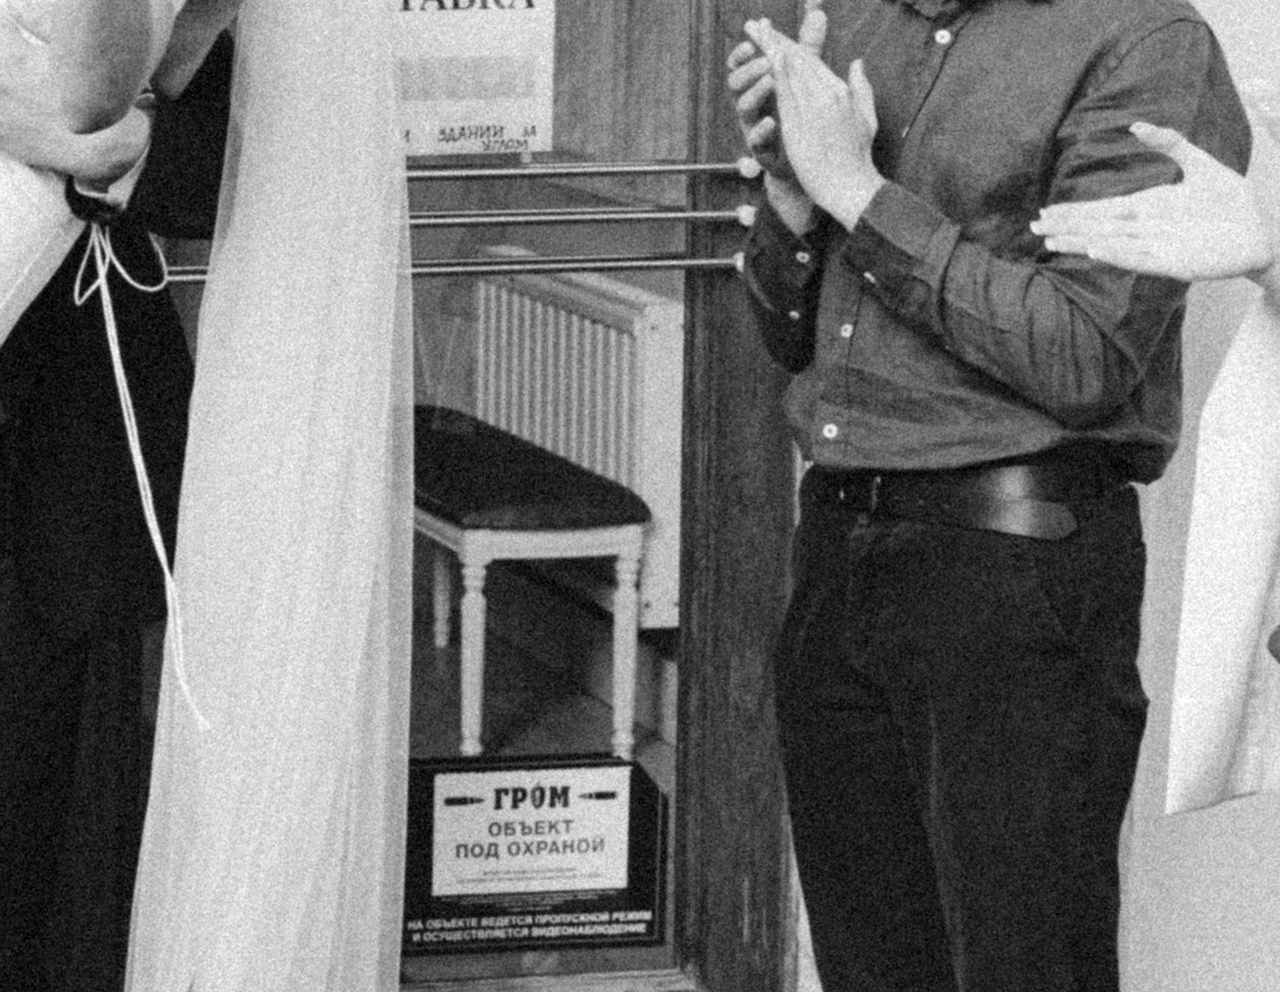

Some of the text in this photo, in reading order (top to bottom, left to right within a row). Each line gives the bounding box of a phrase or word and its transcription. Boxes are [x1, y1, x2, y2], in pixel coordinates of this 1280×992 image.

[493, 783, 571, 810] ГРОМ
[488, 819, 575, 837] ОБЪЕКТ
[455, 837, 606, 860] ПОД ОХРАНОЙ
[407, 919, 424, 930] НА
[425, 916, 479, 930] ОБЪЕКТЕ
